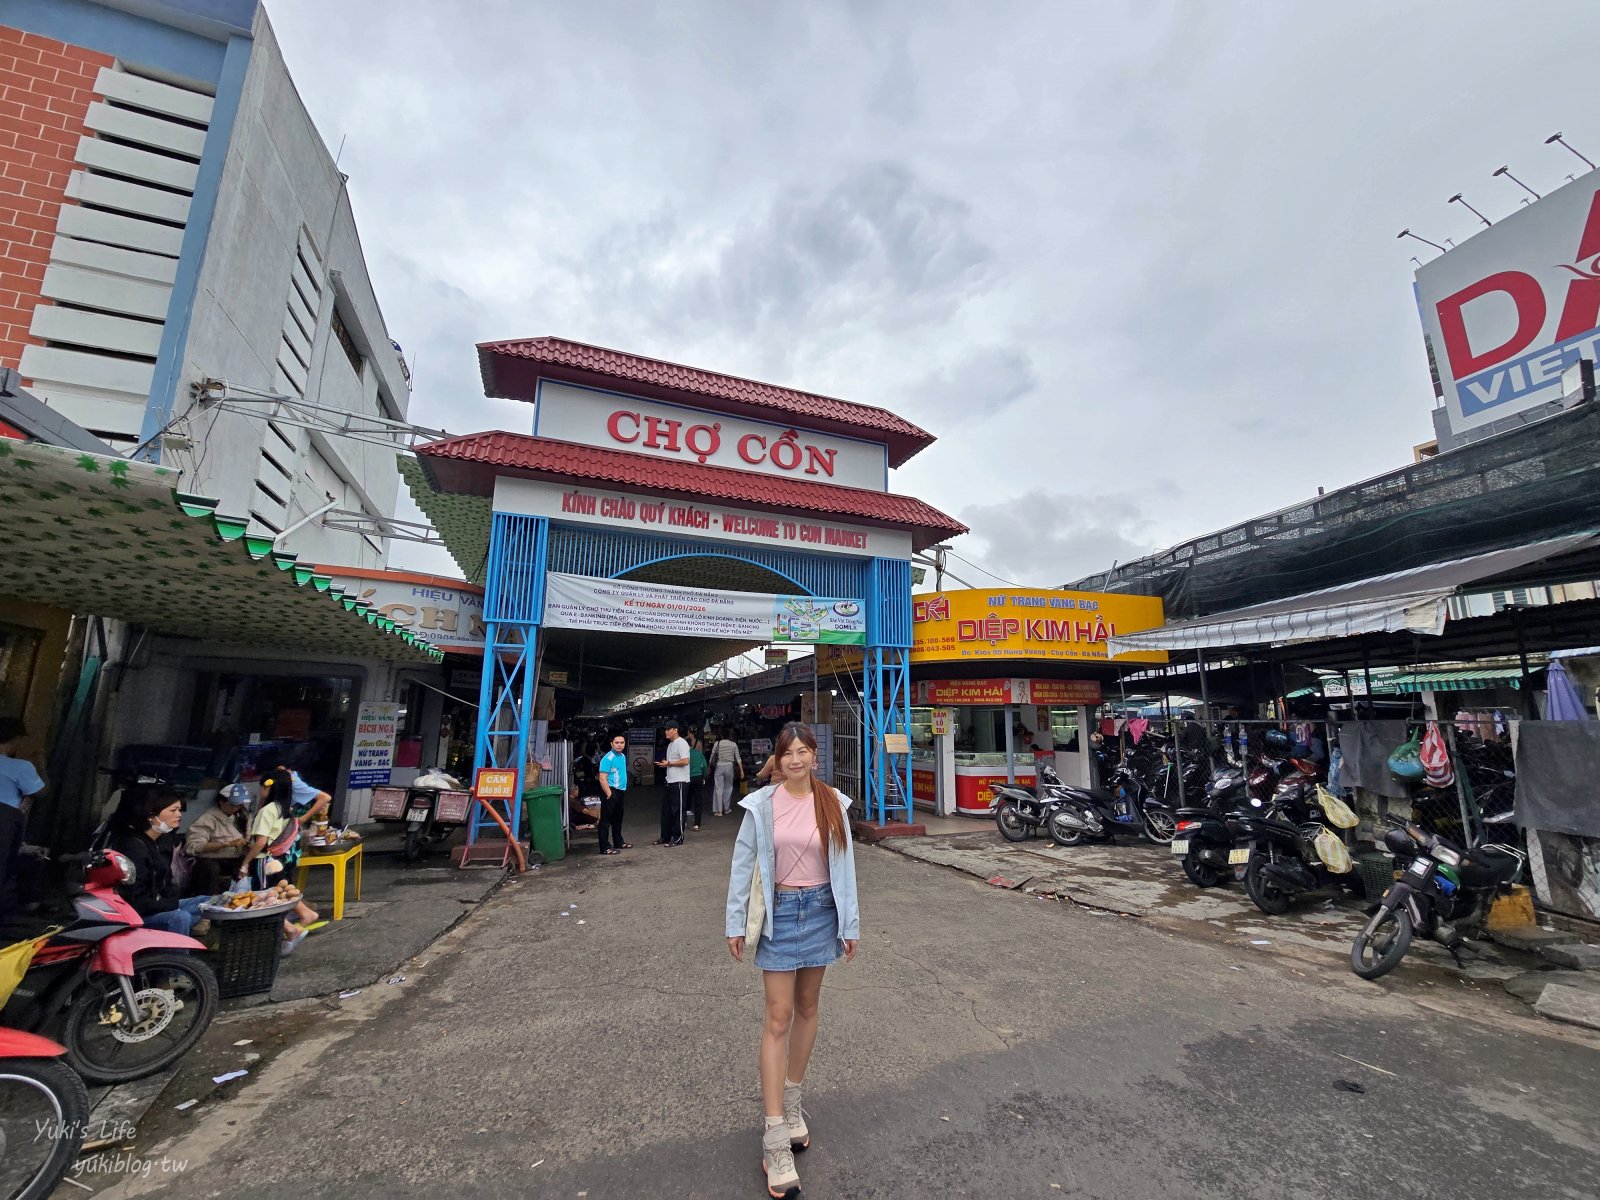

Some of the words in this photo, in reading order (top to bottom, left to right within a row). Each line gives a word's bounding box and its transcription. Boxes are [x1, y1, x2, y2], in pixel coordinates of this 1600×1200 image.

[607, 410, 721, 463] CHỢ
[737, 429, 838, 477] CỒN
[562, 490, 597, 515] KÍNH
[600, 496, 636, 520] CHÀO
[639, 502, 666, 524] QUÝ
[668, 506, 710, 529] KHÁCH
[722, 513, 779, 539] WELCOME
[782, 522, 797, 540] TO
[800, 524, 822, 544] CON
[825, 528, 868, 549] MARKET
[411, 587, 453, 602] HIỆU
[459, 595, 485, 608] VÀN
[1011, 596, 1046, 608] TRANG
[1049, 596, 1076, 609] VÀNG
[1079, 600, 1099, 613] BẠC
[646, 601, 666, 609] NGÀY
[667, 603, 706, 612] 01/01/2026
[957, 612, 1020, 645] DIỆP
[1026, 618, 1071, 642] KIM
[1074, 614, 1116, 643] HẢI
[936, 687, 958, 698] DIỆP
[984, 686, 1003, 696] HẢI
[359, 722, 377, 733] BÍCH
[379, 724, 395, 733] NGA
[369, 749, 389, 757] TRANG
[354, 758, 373, 767] VÀNG
[378, 759, 390, 767] BẠC
